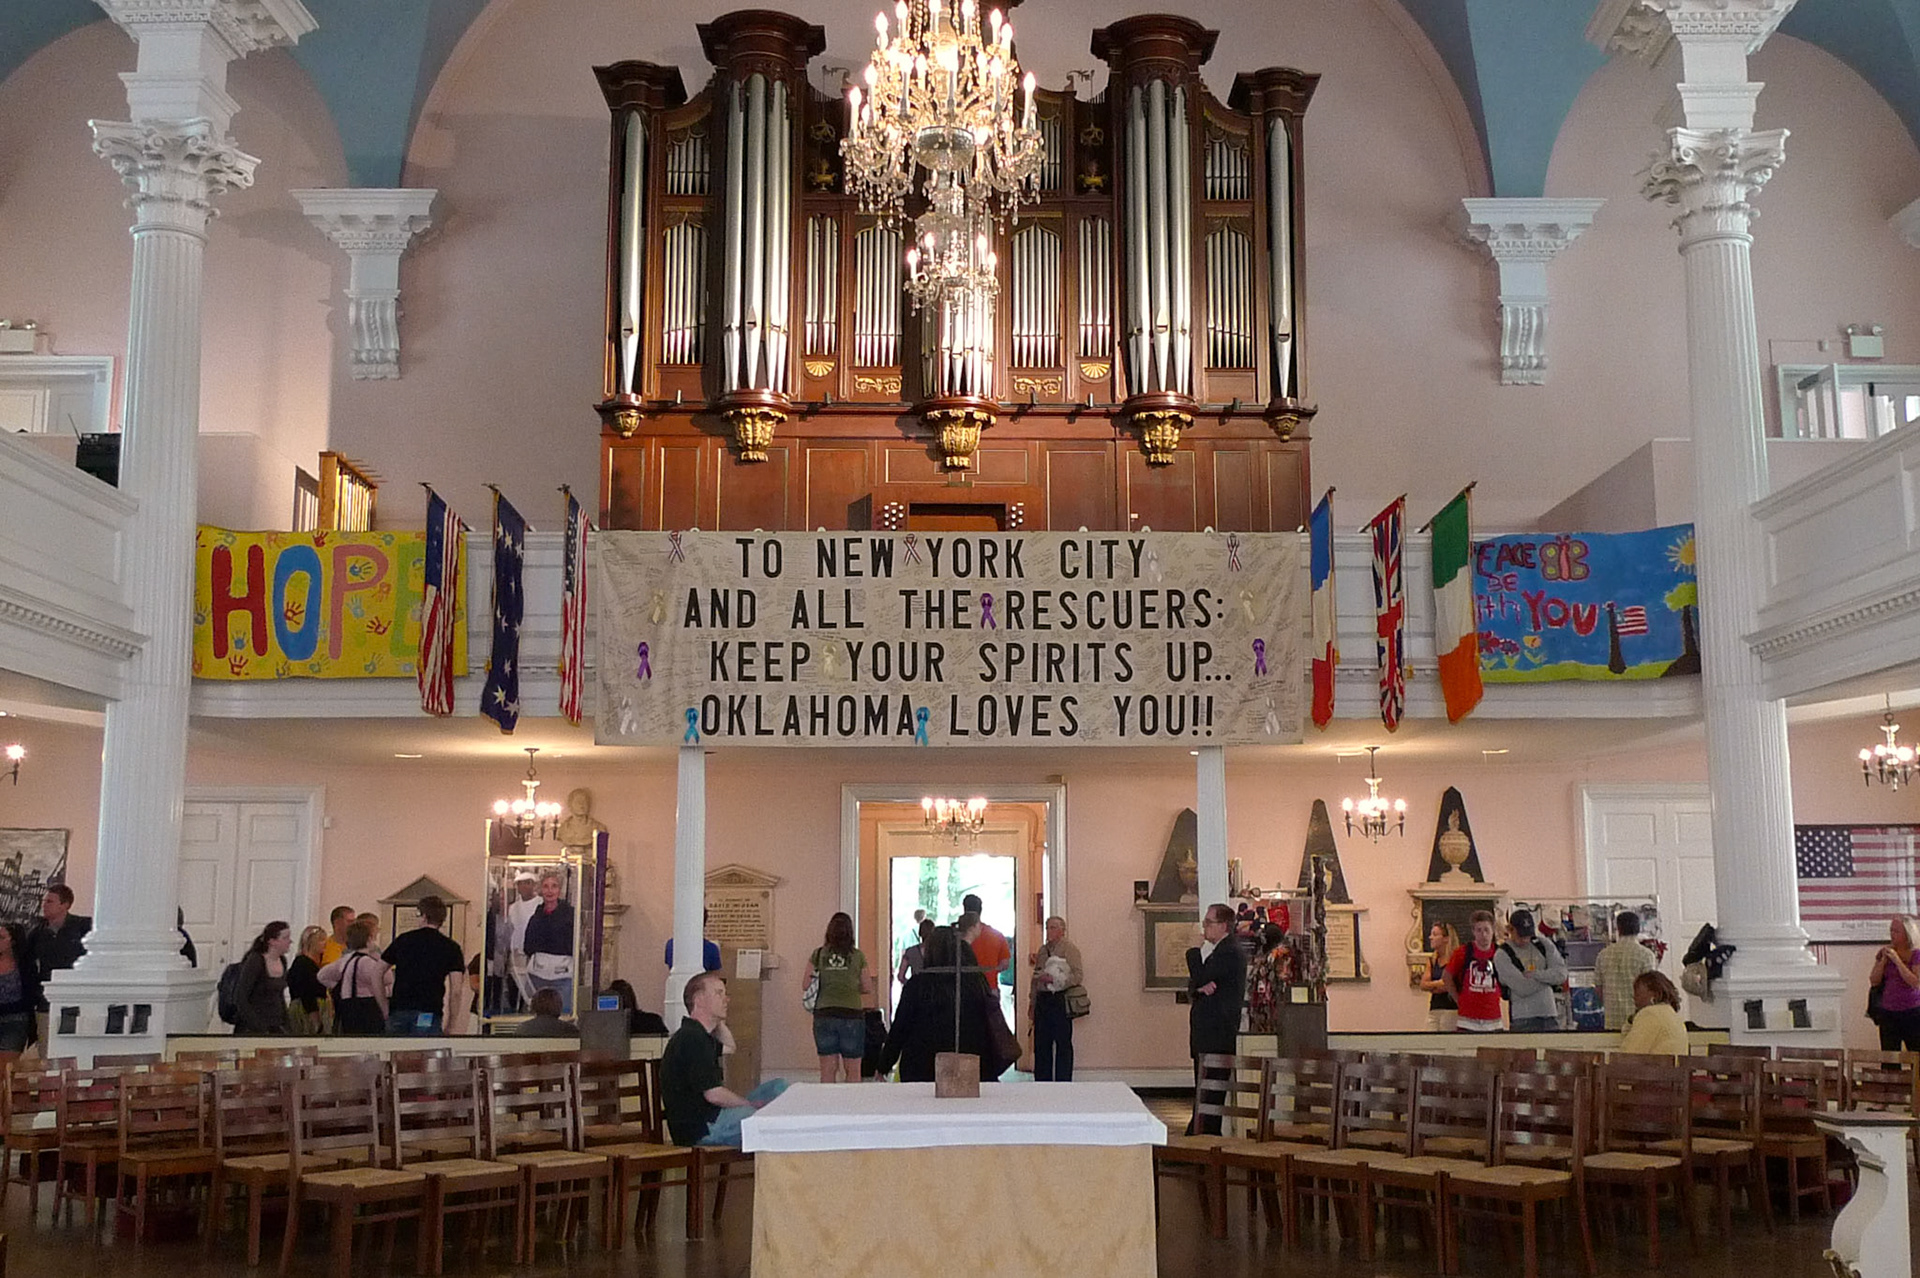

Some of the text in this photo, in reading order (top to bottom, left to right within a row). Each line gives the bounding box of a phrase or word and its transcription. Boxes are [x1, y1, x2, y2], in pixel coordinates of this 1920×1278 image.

[736, 537, 1146, 579] TO NEW YORK CITY
[1474, 541, 1537, 577] EACE
[211, 544, 427, 661] HOPE
[684, 588, 1224, 630] AND ALL THE RESCUERS:
[1521, 589, 1599, 636] YOU
[711, 641, 1232, 683] KEEP YOUR SPIRITS UP...
[702, 694, 915, 736] OKLAHOMA
[949, 694, 1079, 736] LOVES
[1113, 695, 1214, 737] YOU!!
